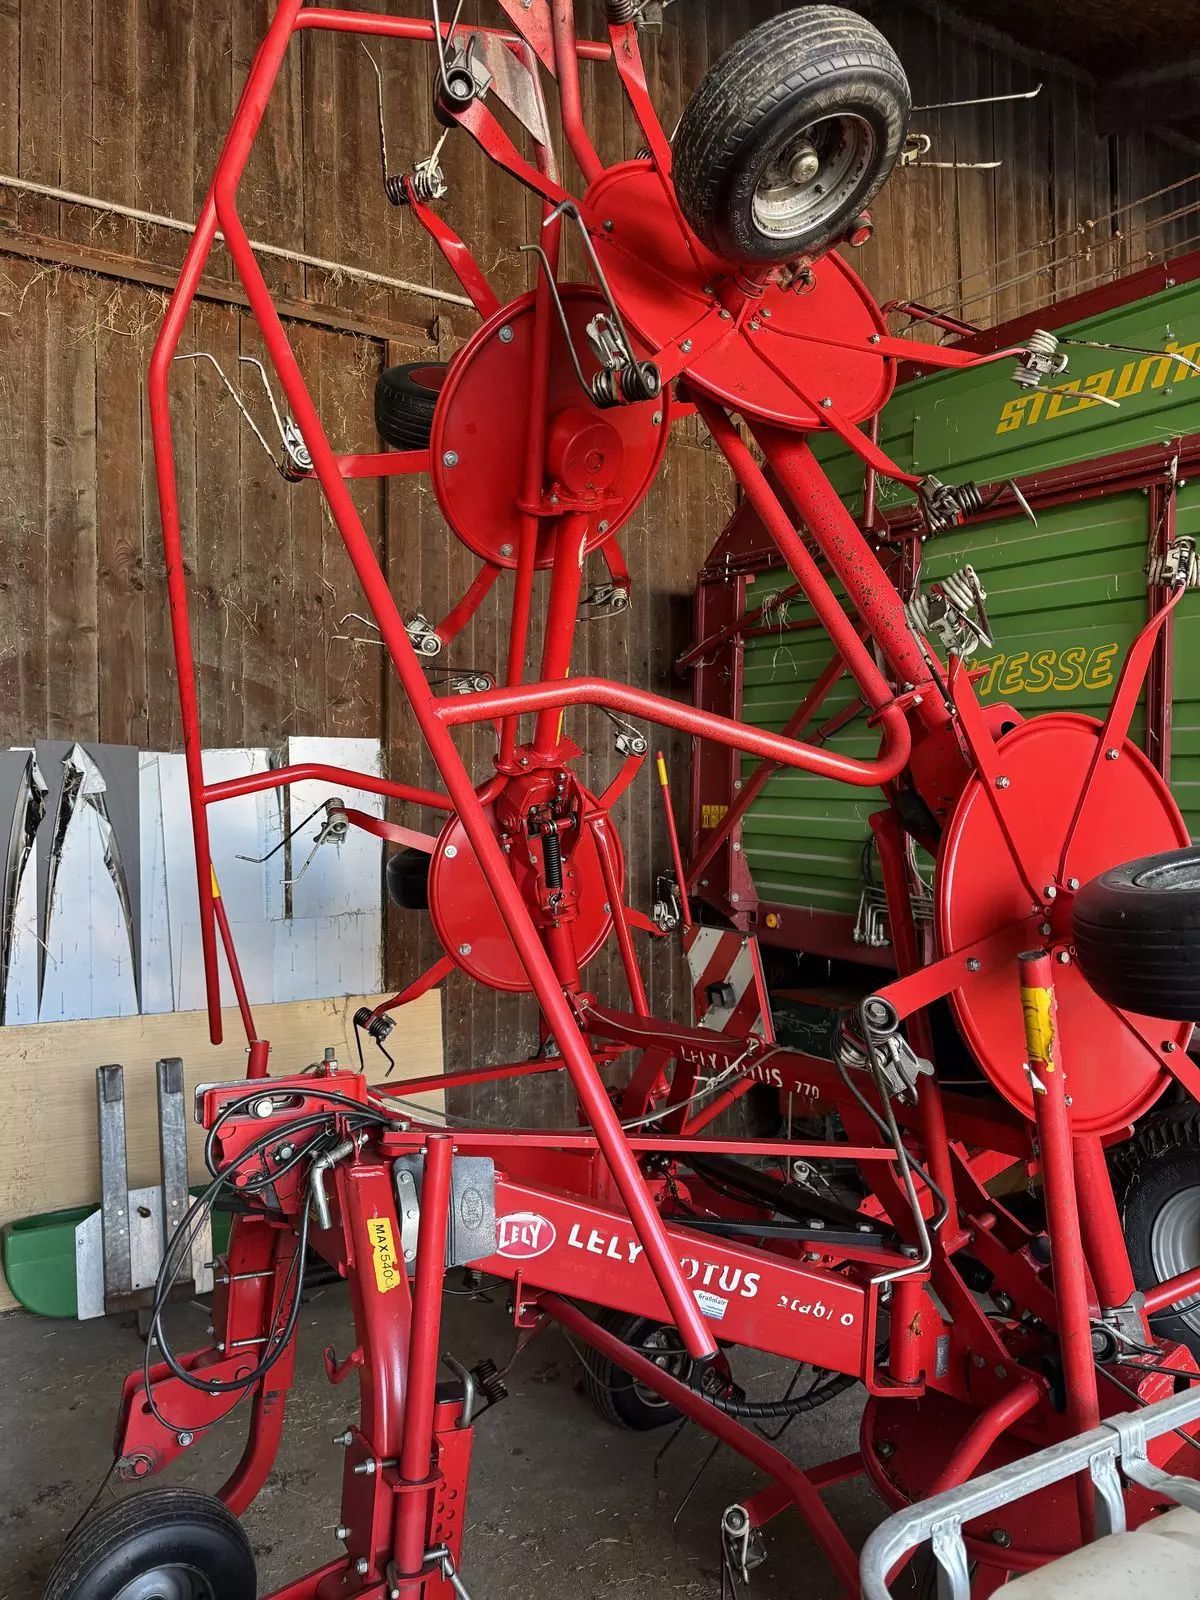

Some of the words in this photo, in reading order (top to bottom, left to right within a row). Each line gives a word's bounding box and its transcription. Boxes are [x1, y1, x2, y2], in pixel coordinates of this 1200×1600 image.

[965, 643, 1119, 696] TESSE
[374, 1224, 389, 1253] MAX
[498, 1216, 543, 1250] LELY
[567, 1223, 644, 1264] LELY
[679, 1257, 761, 1298] OTUS
